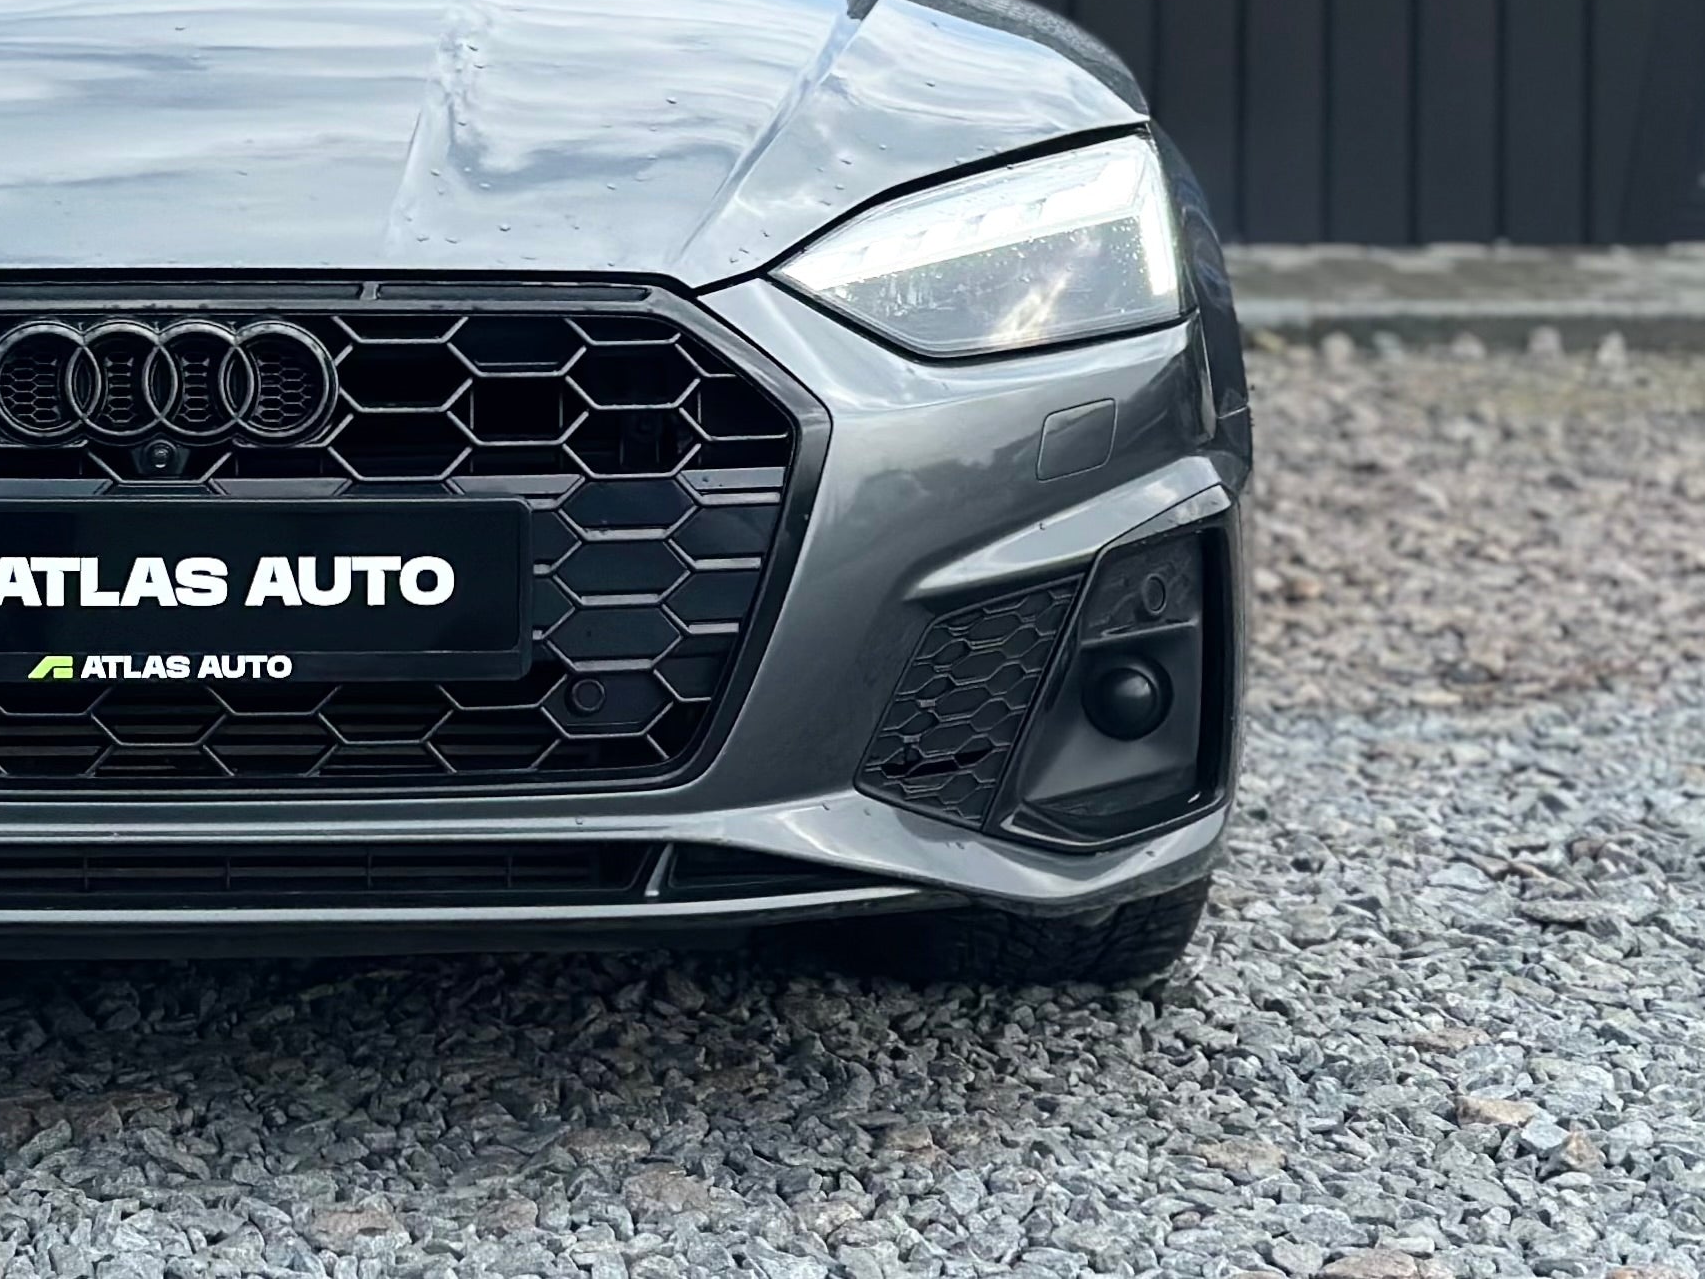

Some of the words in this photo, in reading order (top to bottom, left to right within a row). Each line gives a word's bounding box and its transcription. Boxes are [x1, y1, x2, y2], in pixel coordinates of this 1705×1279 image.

[244, 555, 455, 607] AUTO
[80, 655, 192, 679] ATLAS
[197, 654, 293, 679] AUTO
